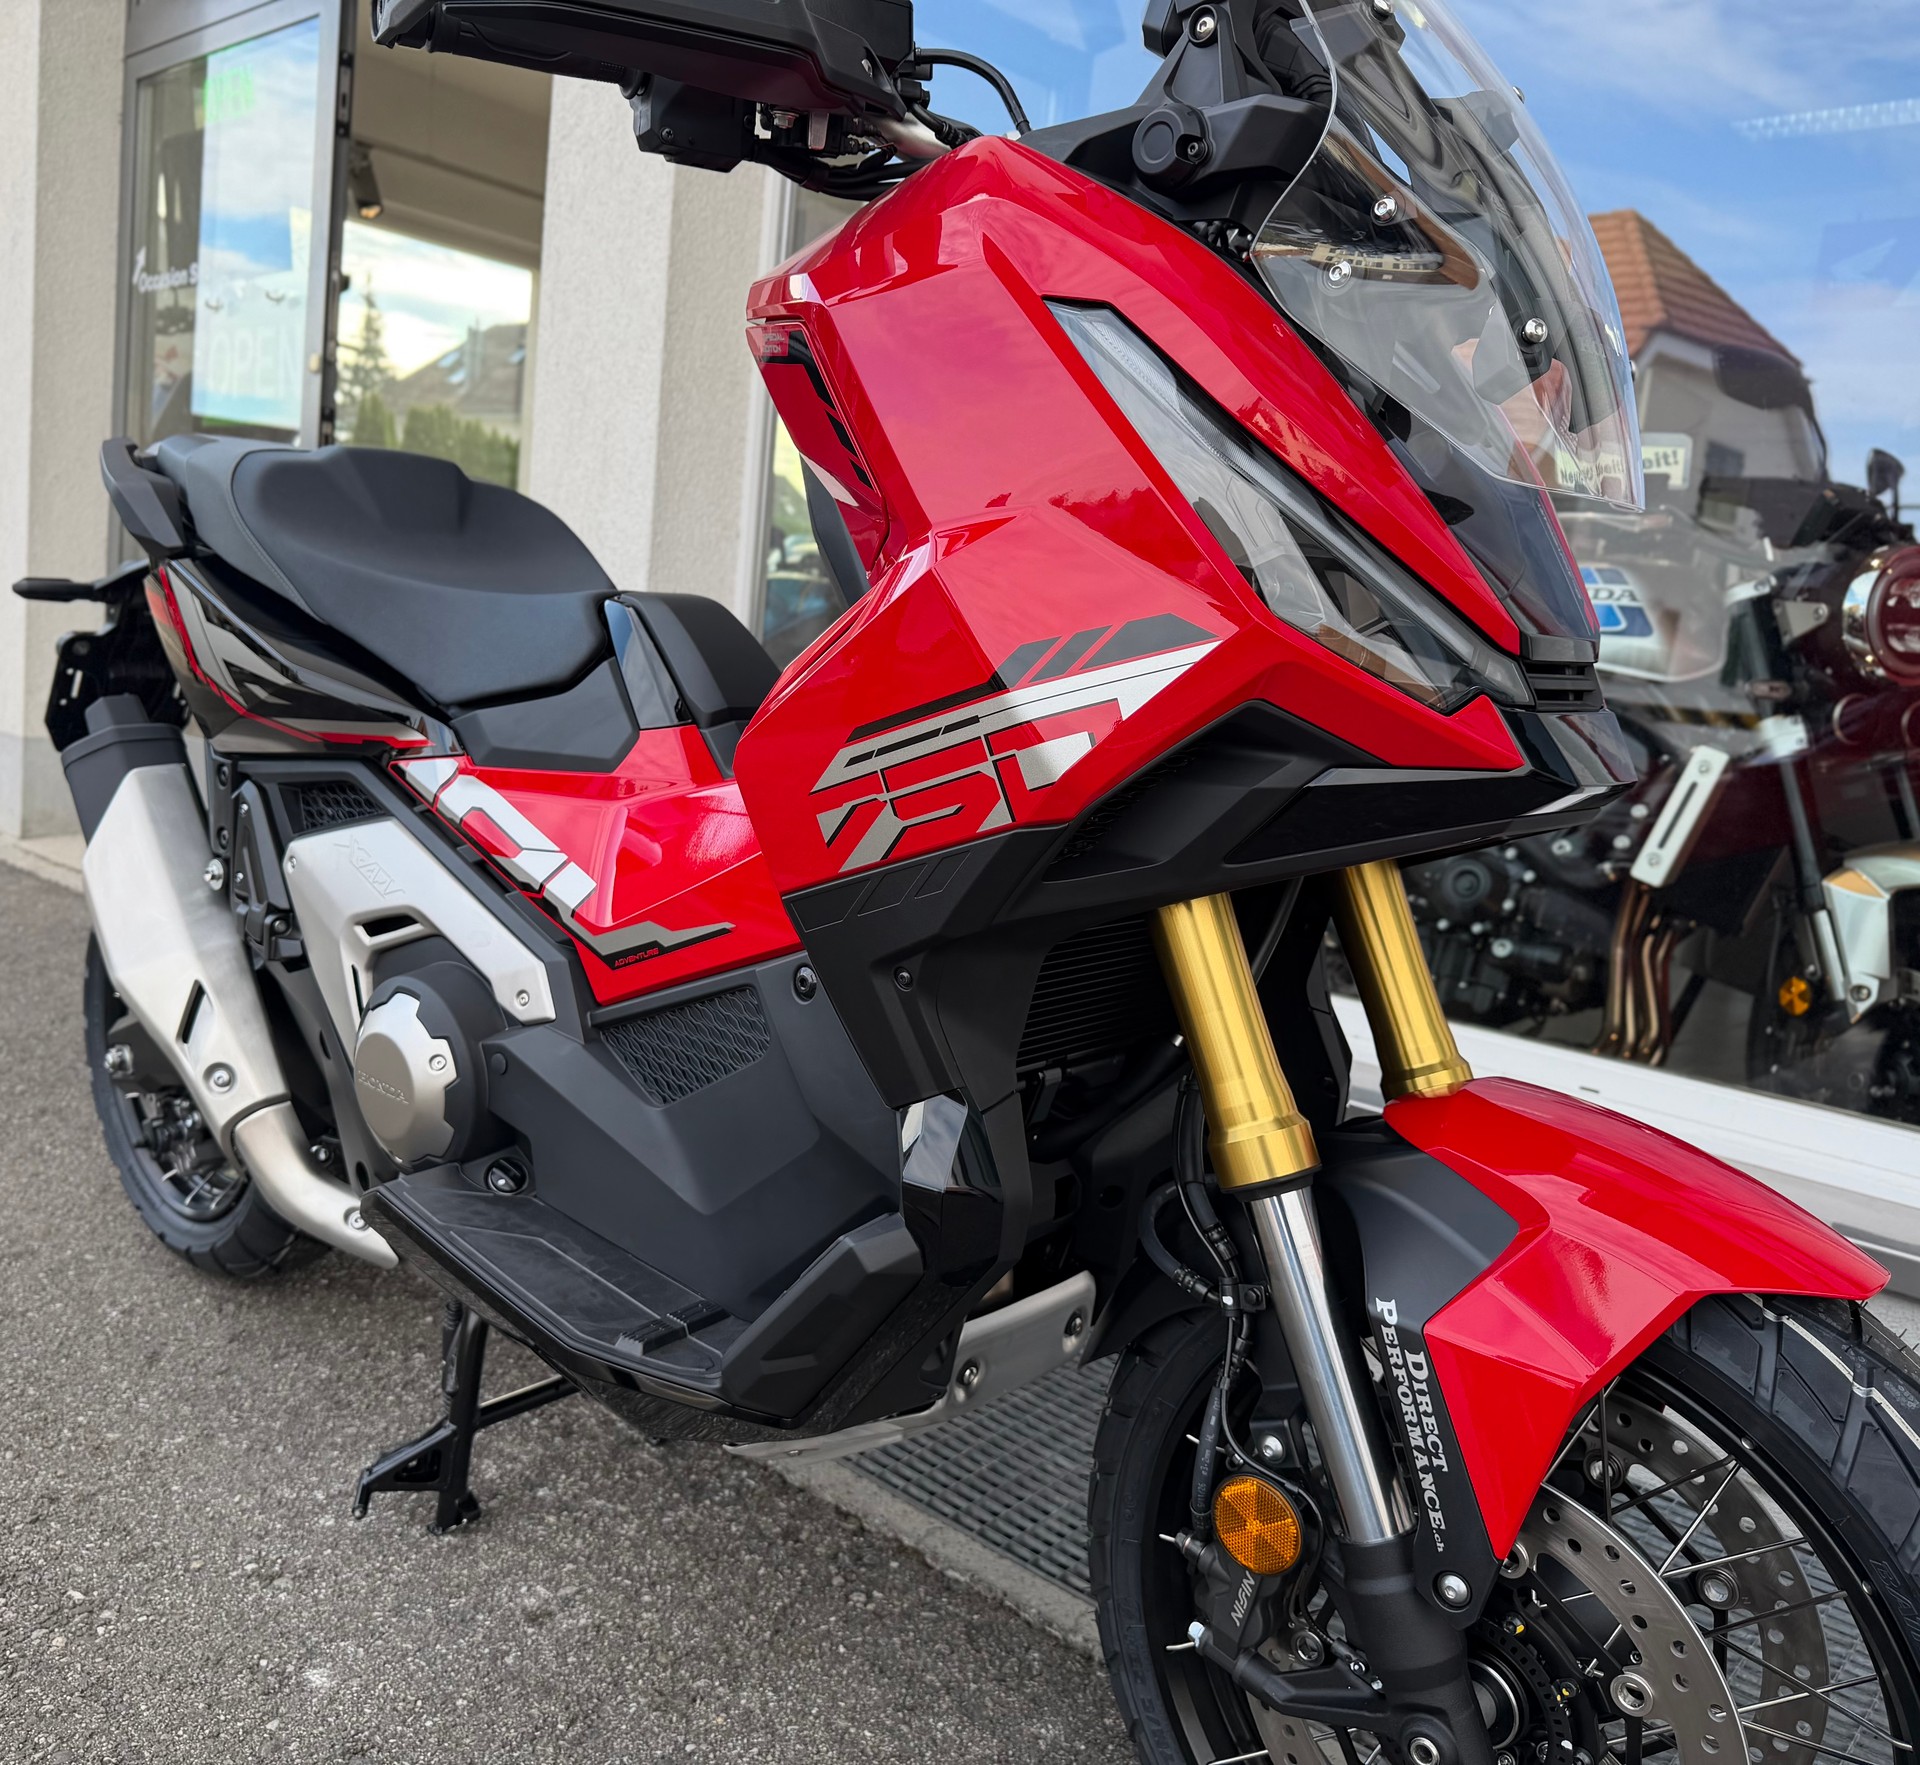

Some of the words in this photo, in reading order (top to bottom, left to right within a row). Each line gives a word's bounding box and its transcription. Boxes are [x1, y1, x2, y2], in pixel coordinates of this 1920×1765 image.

[614, 947, 660, 967] ADVENTURE
[1404, 1349, 1449, 1472] DIRECT
[1230, 1569, 1256, 1628] NISSIN
